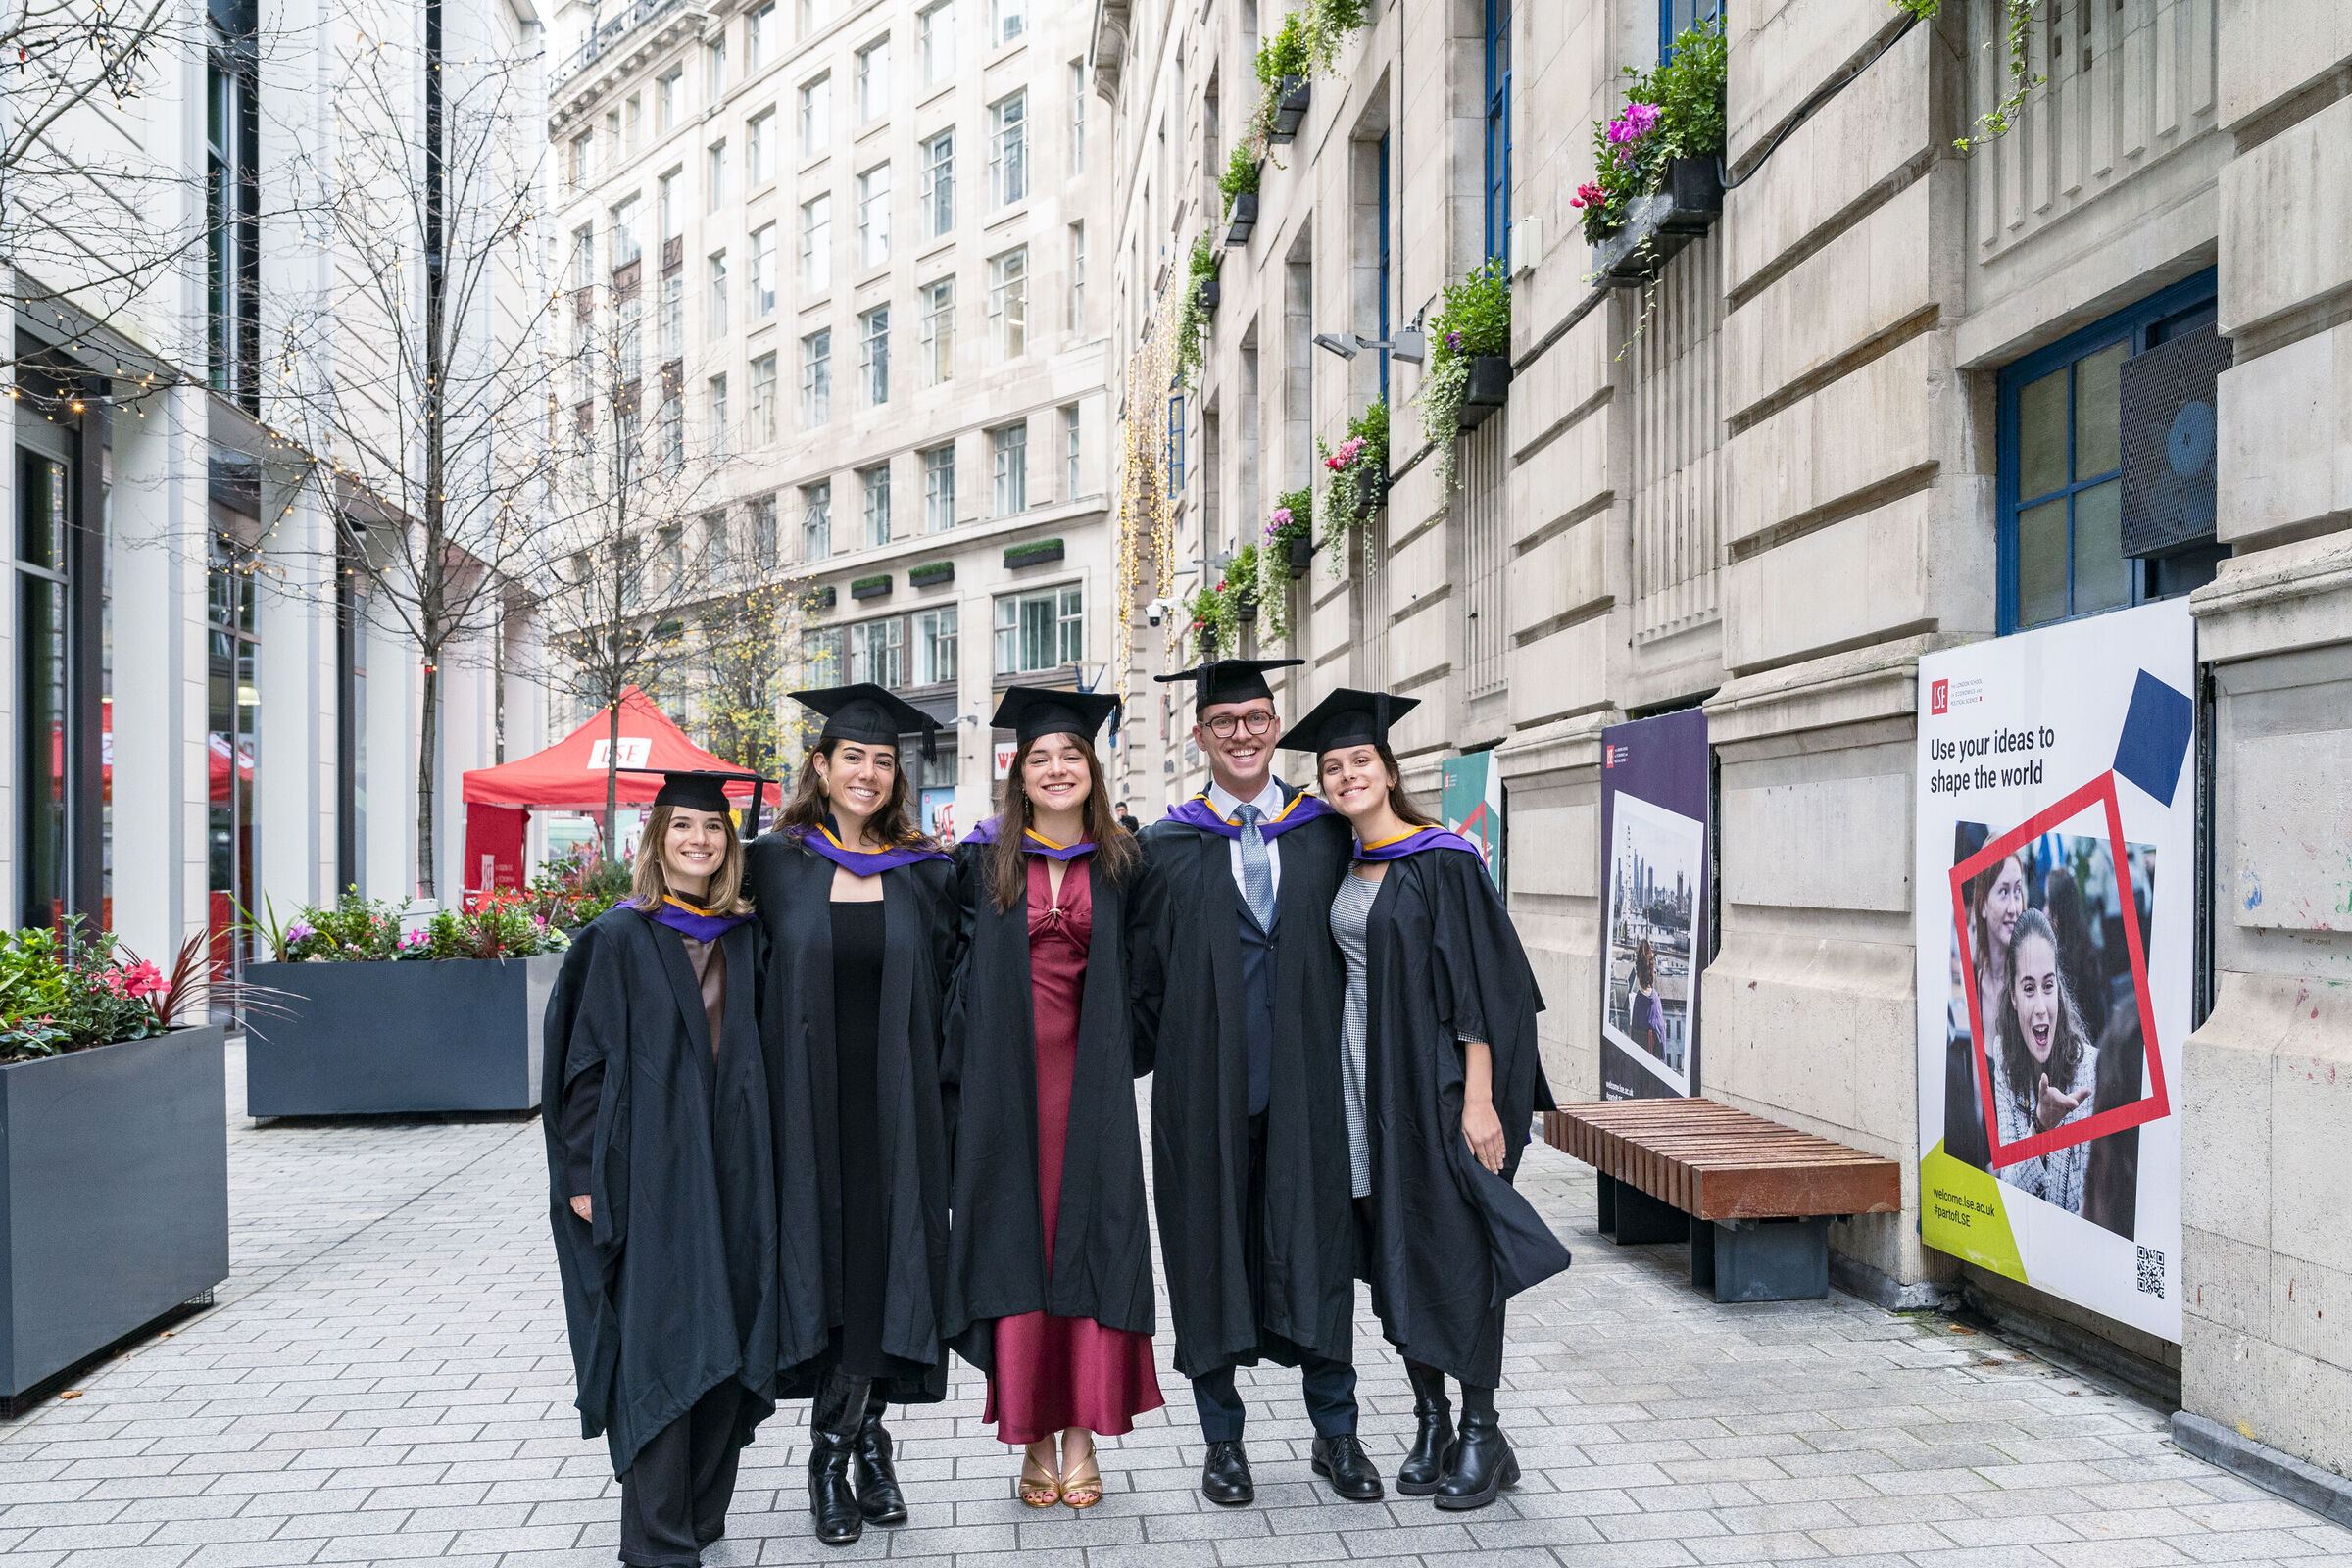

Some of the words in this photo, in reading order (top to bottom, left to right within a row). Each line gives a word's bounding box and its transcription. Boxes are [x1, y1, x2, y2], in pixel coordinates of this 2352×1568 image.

[1934, 685, 1946, 710] LSE
[1931, 738, 1956, 760] Use
[1959, 736, 1990, 763] your
[1994, 727, 2034, 754] ideas
[2038, 725, 2055, 748] to
[1930, 768, 1971, 797] shape
[1974, 764, 1997, 790] the
[2001, 758, 2043, 787] world
[1933, 1187, 1995, 1217] welcome.lse.ac.uk
[1934, 1203, 1971, 1228] #partofLSE
